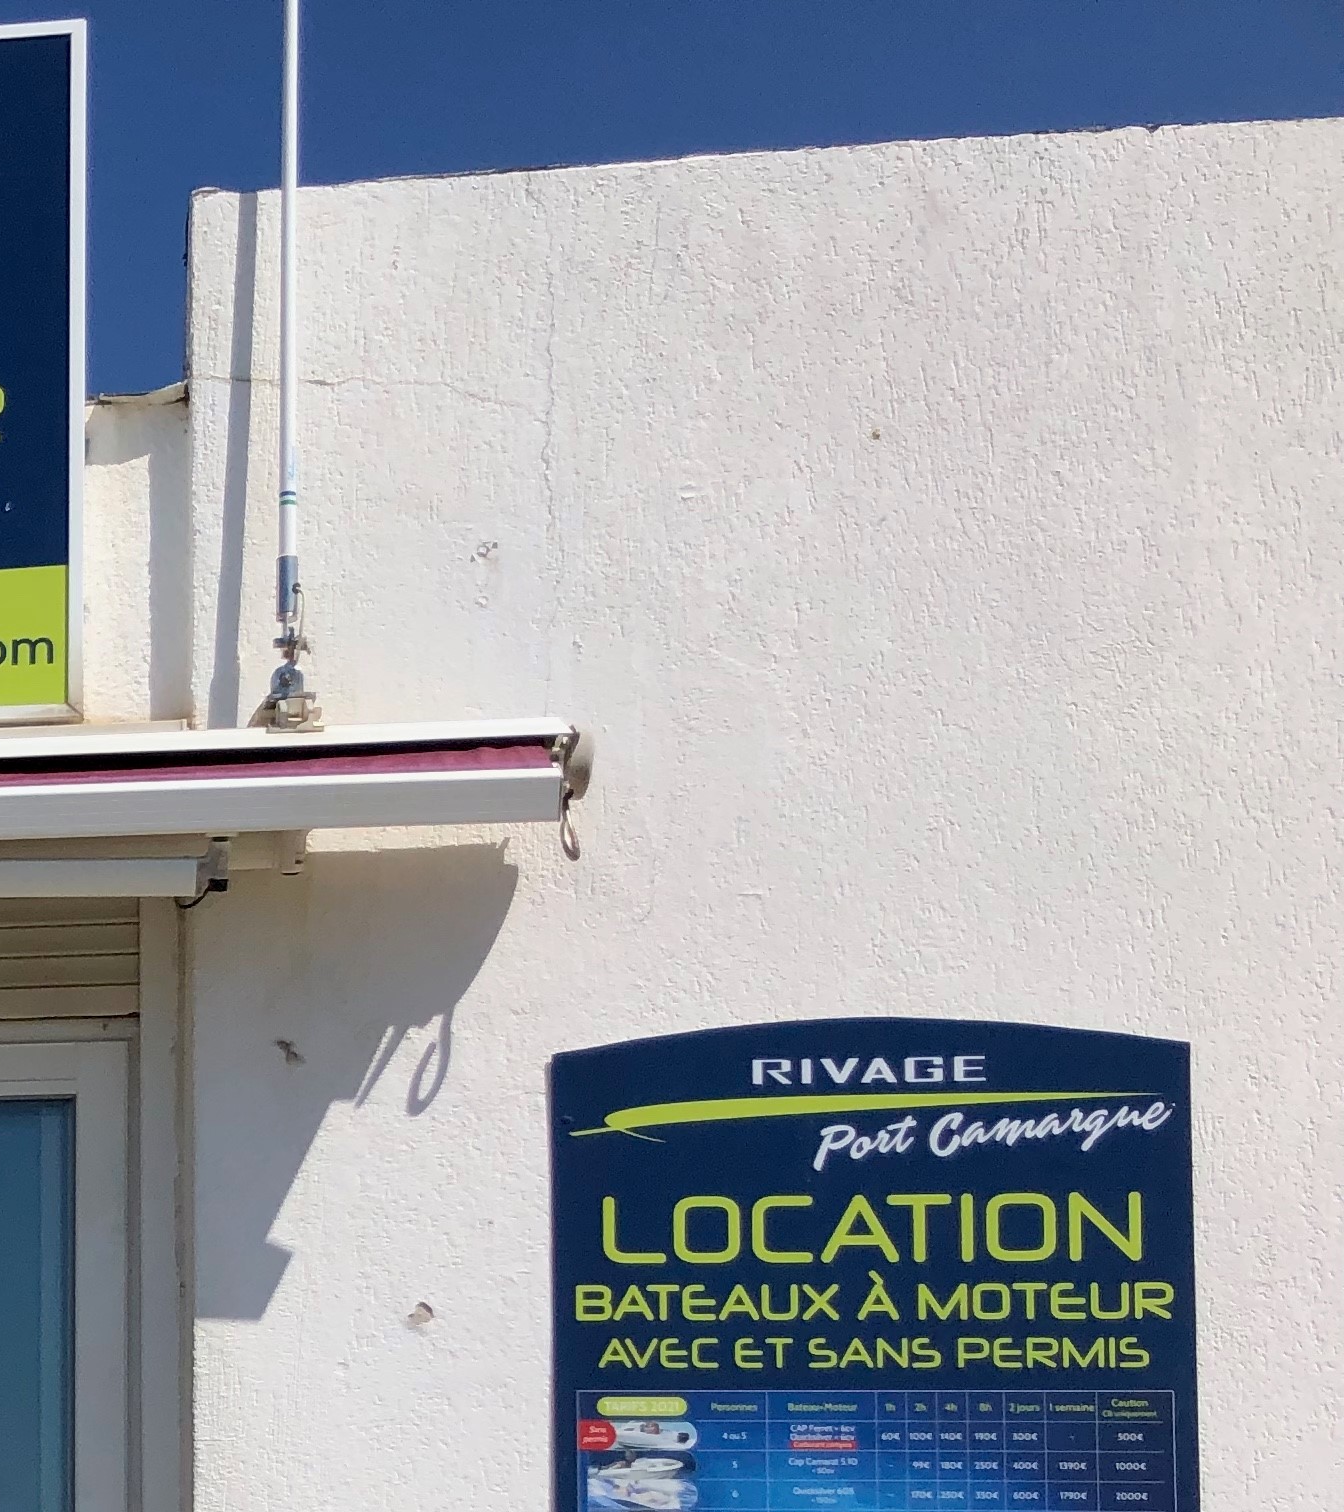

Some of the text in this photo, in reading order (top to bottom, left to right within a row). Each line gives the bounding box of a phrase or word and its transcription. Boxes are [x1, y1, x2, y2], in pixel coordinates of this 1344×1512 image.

[752, 1056, 986, 1084] RIVAGE
[813, 1102, 1172, 1171] Port Camargue
[603, 1192, 1142, 1264] LOCATION
[576, 1270, 1174, 1321] BATEAUX À MOTEUR
[599, 1337, 1149, 1368] AVEC ET SANS PERMIS
[711, 1402, 758, 1412] Personnes
[1016, 1403, 1040, 1414] jours
[1055, 1403, 1095, 1412] semaine
[1111, 1398, 1149, 1407] Caution
[881, 1432, 900, 1440] 60€
[909, 1432, 933, 1440] 100€
[1117, 1433, 1144, 1441] 500€
[1013, 1461, 1038, 1470] 400€
[1013, 1491, 1148, 1500] 600€ 2000€
